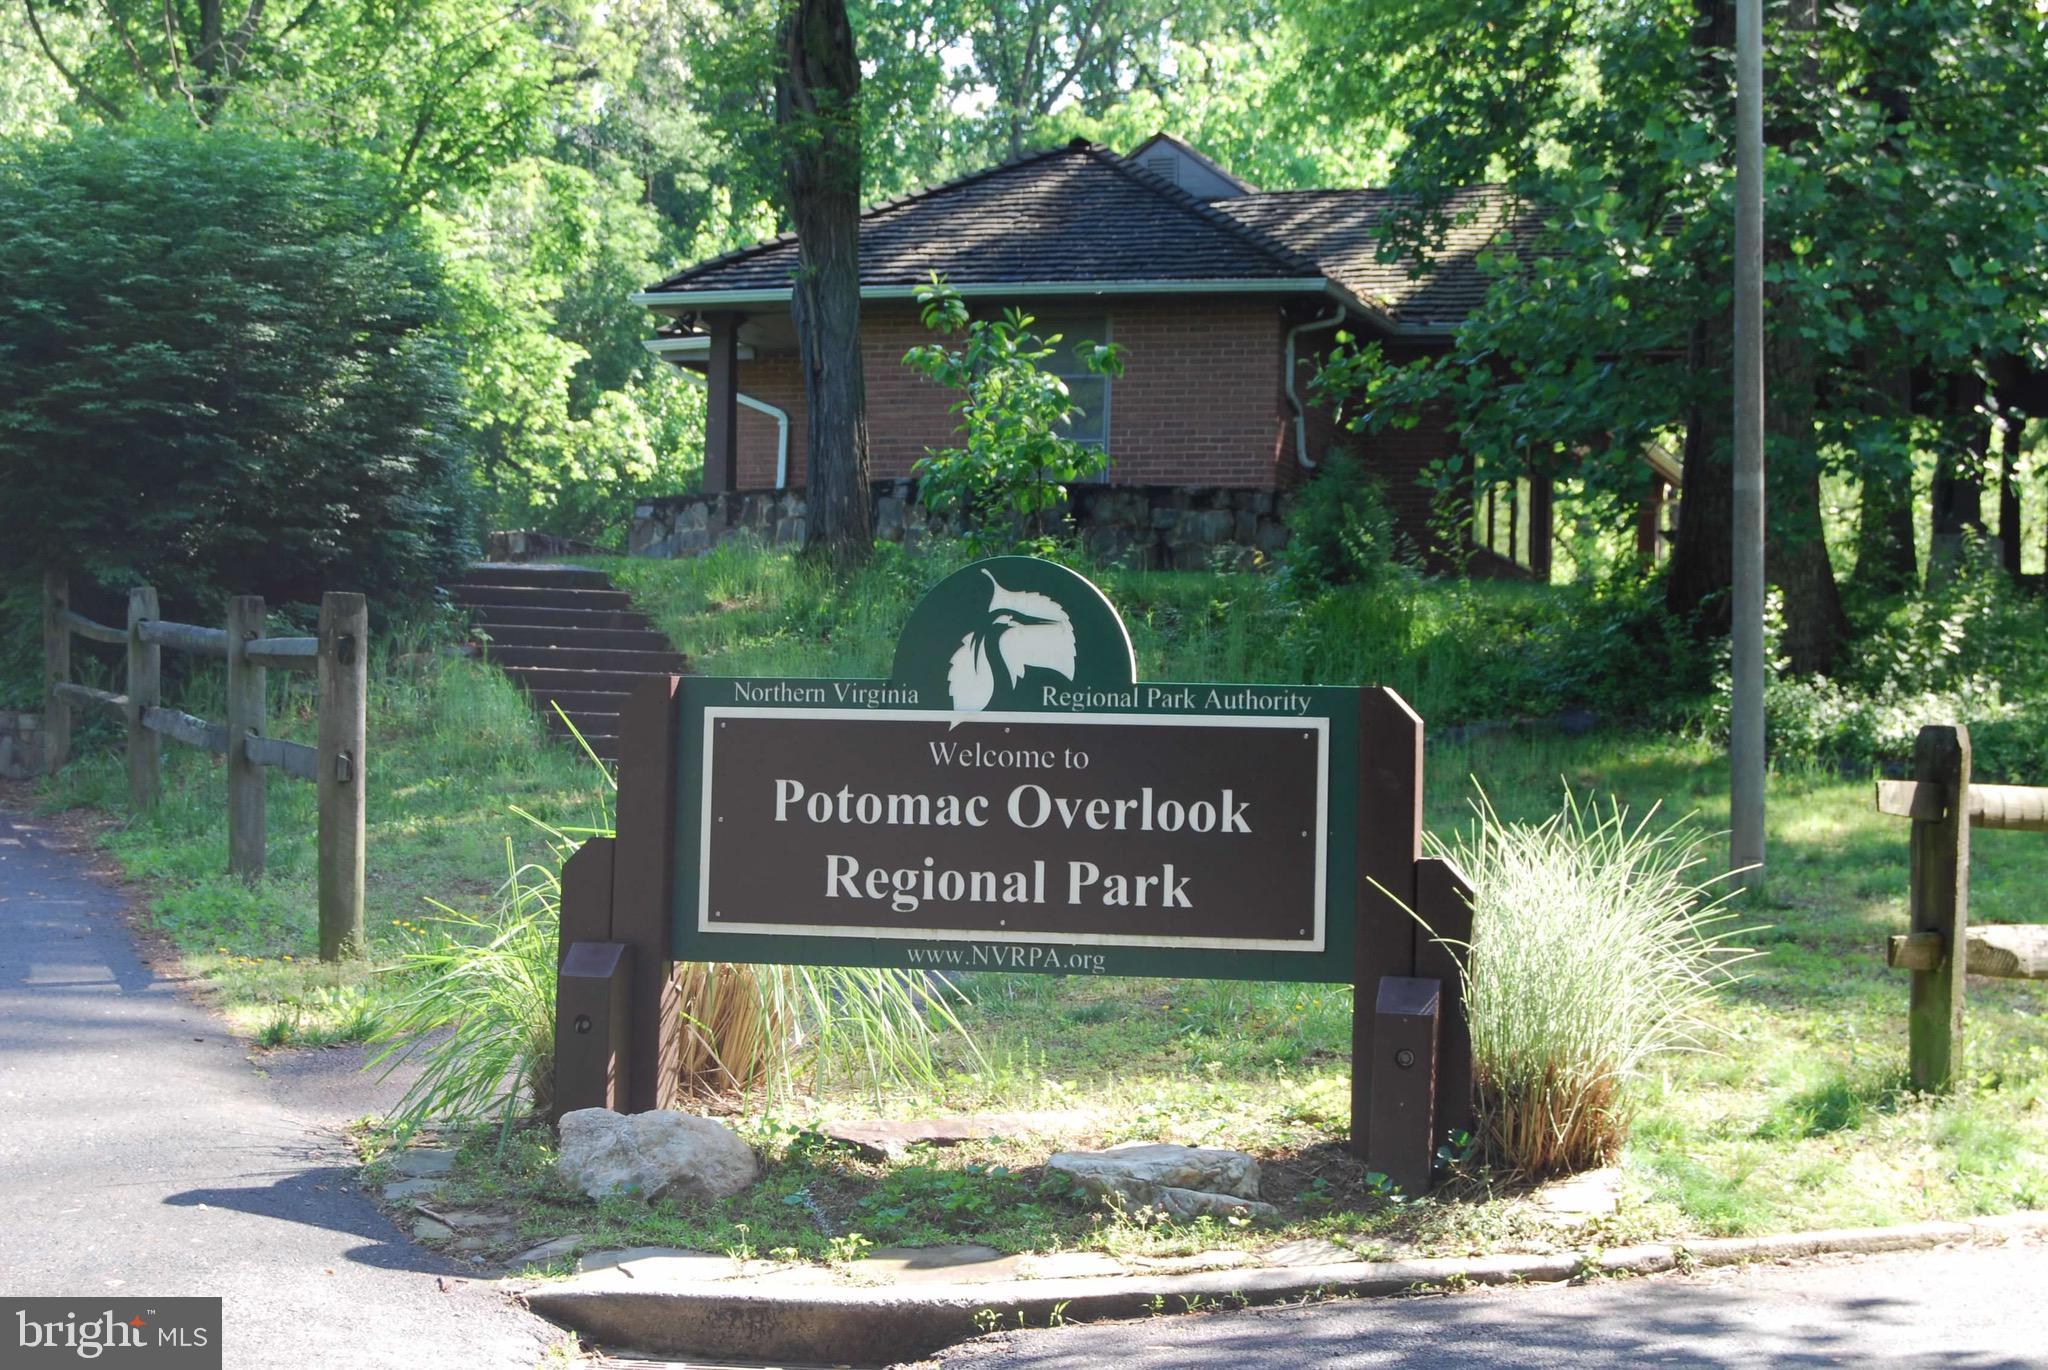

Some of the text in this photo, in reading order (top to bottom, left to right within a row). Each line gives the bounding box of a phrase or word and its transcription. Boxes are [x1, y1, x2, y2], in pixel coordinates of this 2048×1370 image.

[735, 682, 1312, 715] Northern Virginia Regional Park Authority
[930, 741, 1090, 768] Welcome to
[774, 779, 1252, 833] Potomac Overlook
[825, 854, 1193, 913] Regional Park
[908, 946, 1106, 974] www.NVRPA.org
